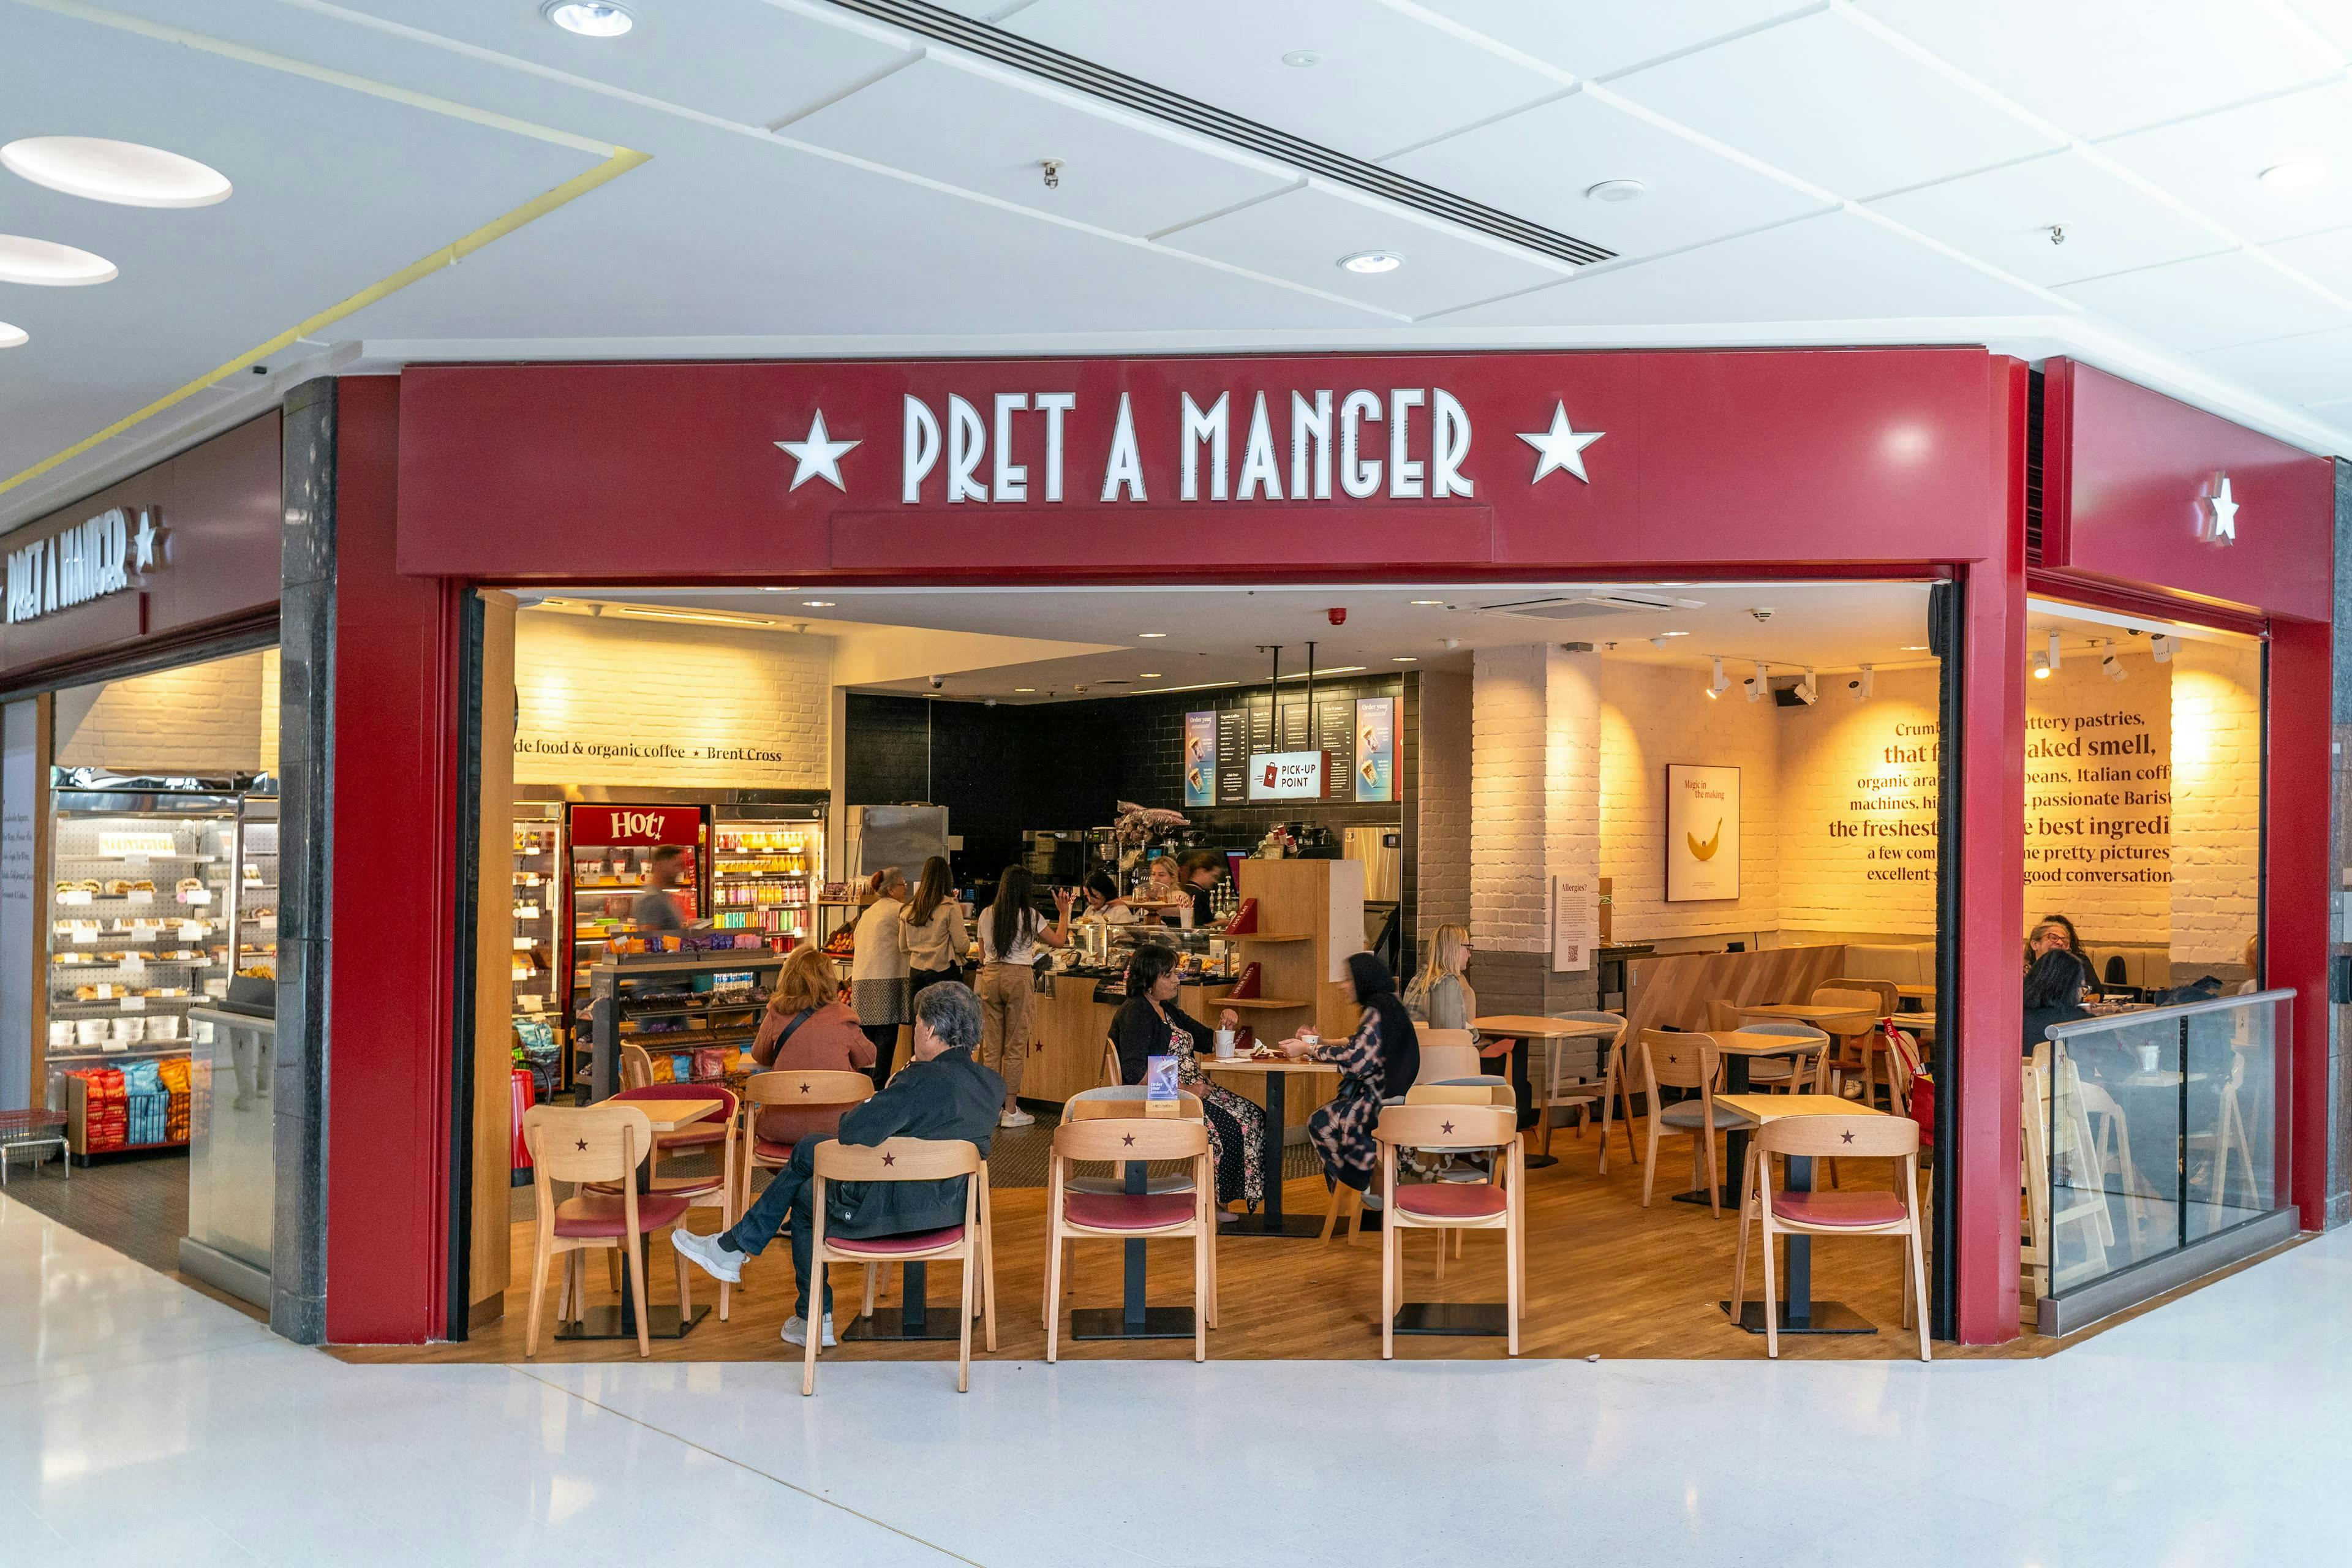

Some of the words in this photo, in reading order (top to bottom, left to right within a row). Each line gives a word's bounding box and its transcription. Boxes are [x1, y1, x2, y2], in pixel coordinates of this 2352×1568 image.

[902, 392, 1076, 503] PRET
[1099, 391, 1148, 502] A
[1180, 387, 1474, 502] MANGER
[2075, 711, 2145, 731] pastries,
[537, 739, 568, 754] food
[573, 741, 583, 754] &
[588, 743, 641, 759] organic
[644, 744, 685, 758] coffee
[707, 747, 744, 760] Brent
[747, 748, 782, 761] Cross
[1884, 745, 1927, 763] that
[2025, 737, 2081, 758] aked
[2087, 734, 2156, 756] smell,
[1282, 764, 1316, 775] PICK-UP
[1858, 774, 1910, 791] organic
[1913, 775, 1939, 787] ara
[2078, 767, 2131, 782] Italian
[2136, 764, 2172, 780] coff
[1281, 777, 1308, 788] POINT
[1684, 780, 1700, 791] Magic
[1701, 780, 1706, 789] in
[1695, 790, 1704, 798] the
[1705, 790, 1724, 801] making
[1850, 796, 1919, 810] machines,
[2032, 792, 2119, 810] passionate
[611, 812, 665, 840] Hot!
[1828, 820, 1858, 837] the
[1863, 820, 1939, 837] freshest
[2039, 818, 2084, 835] best
[1868, 850, 1875, 859] a
[1879, 845, 1903, 859] few
[2044, 846, 2095, 862] pretty
[2100, 845, 2169, 862] pictures
[1868, 867, 1931, 880] excellent
[2023, 868, 2061, 886] good
[2066, 868, 2171, 882] conversation
[1562, 883, 1587, 893] Allergies?
[1232, 916, 1242, 927] JUST
[1240, 905, 1248, 914] EAT
